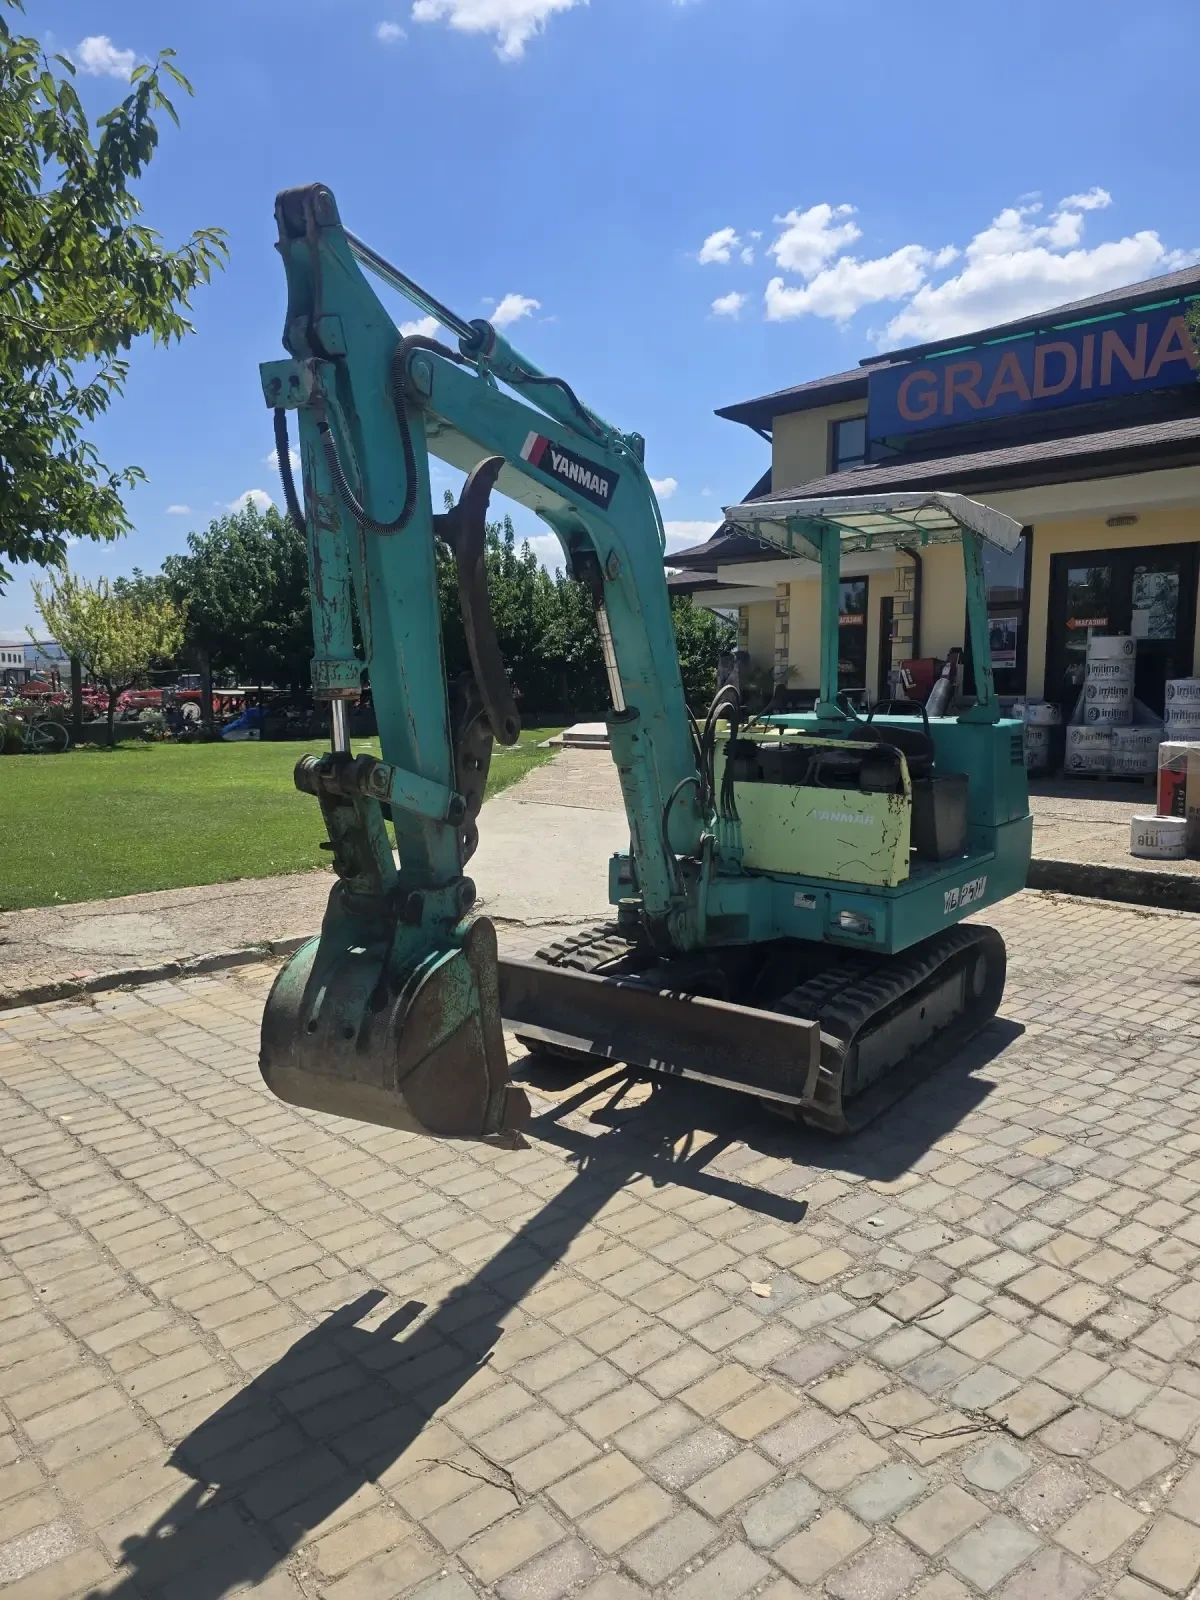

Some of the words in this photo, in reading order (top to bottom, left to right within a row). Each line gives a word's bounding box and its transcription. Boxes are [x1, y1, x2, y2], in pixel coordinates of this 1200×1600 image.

[897, 315, 1197, 421] GRADINA
[550, 449, 609, 498] YANMAR
[1098, 685, 1129, 695] irritime
